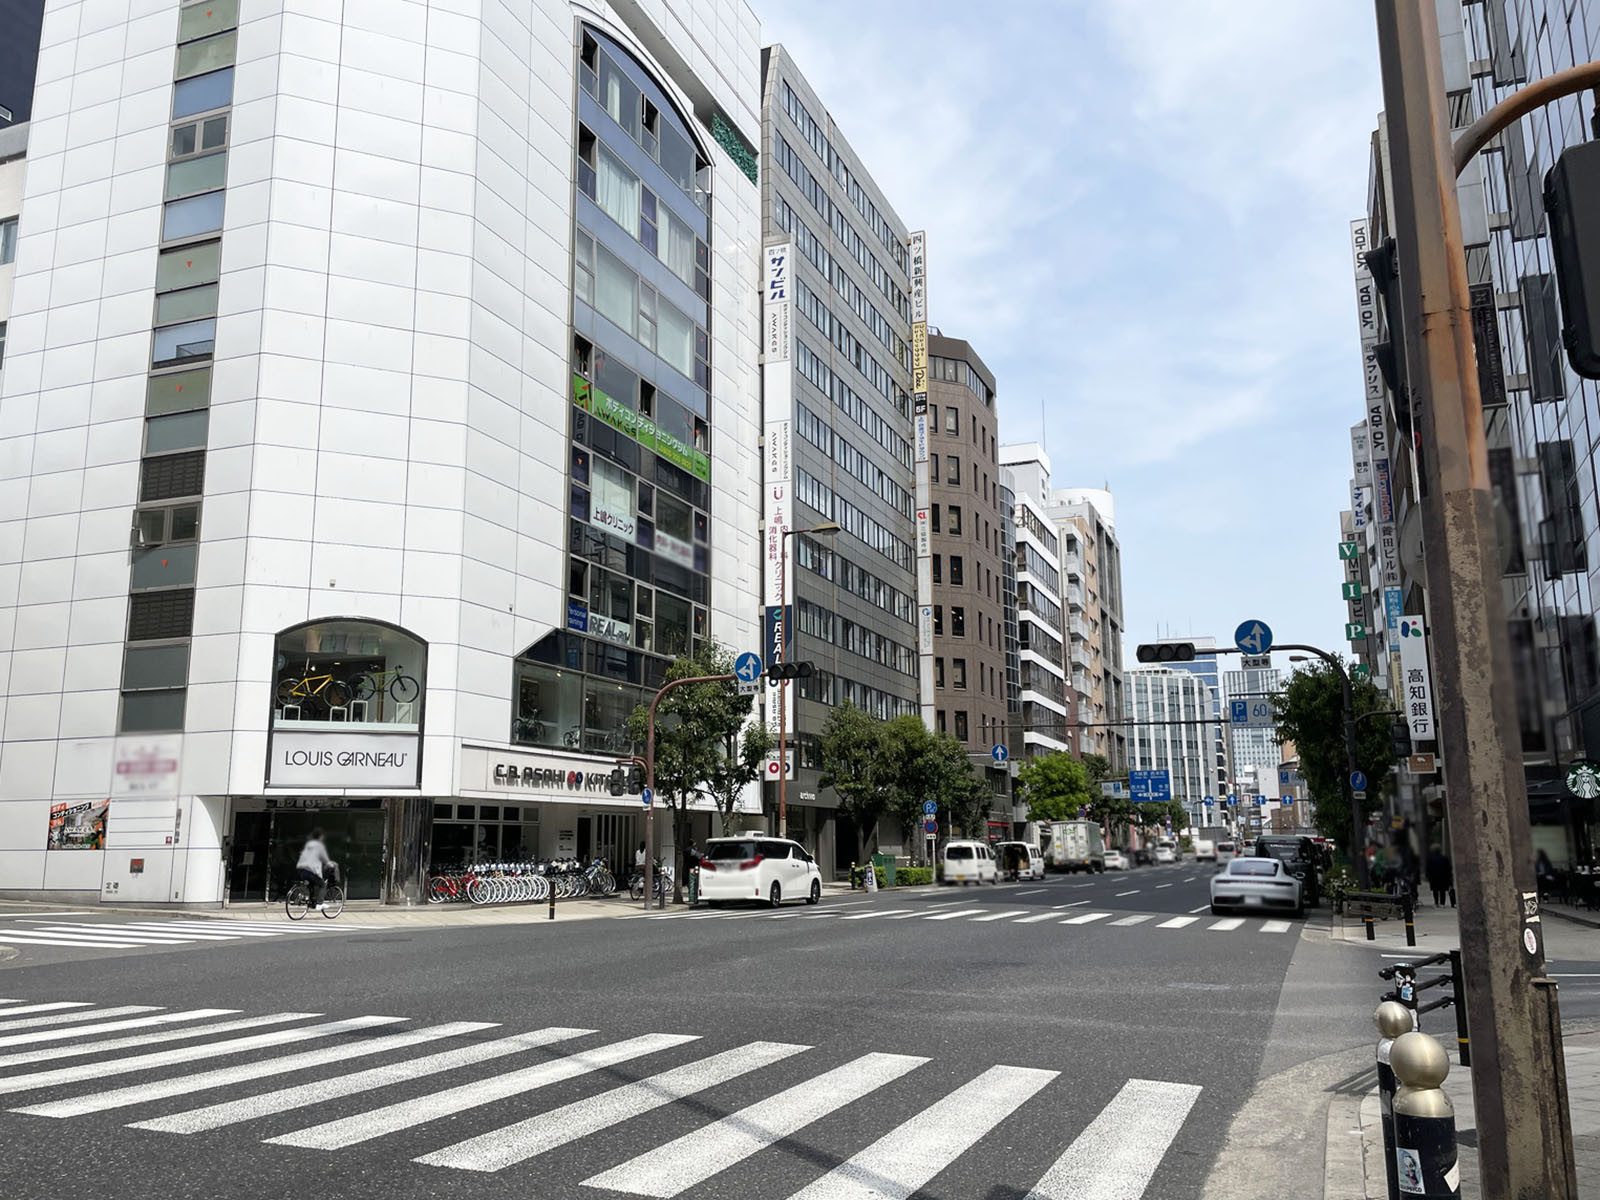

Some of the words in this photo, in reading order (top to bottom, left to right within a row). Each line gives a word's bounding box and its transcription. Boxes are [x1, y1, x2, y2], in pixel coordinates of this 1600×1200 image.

[771, 256, 786, 300] サンビル
[1243, 659, 1269, 667] 大型等
[1407, 669, 1429, 733] 高知銀行
[285, 751, 333, 766] LOUIS
[337, 752, 405, 768] GARNEAU
[523, 766, 566, 784] ASAHI
